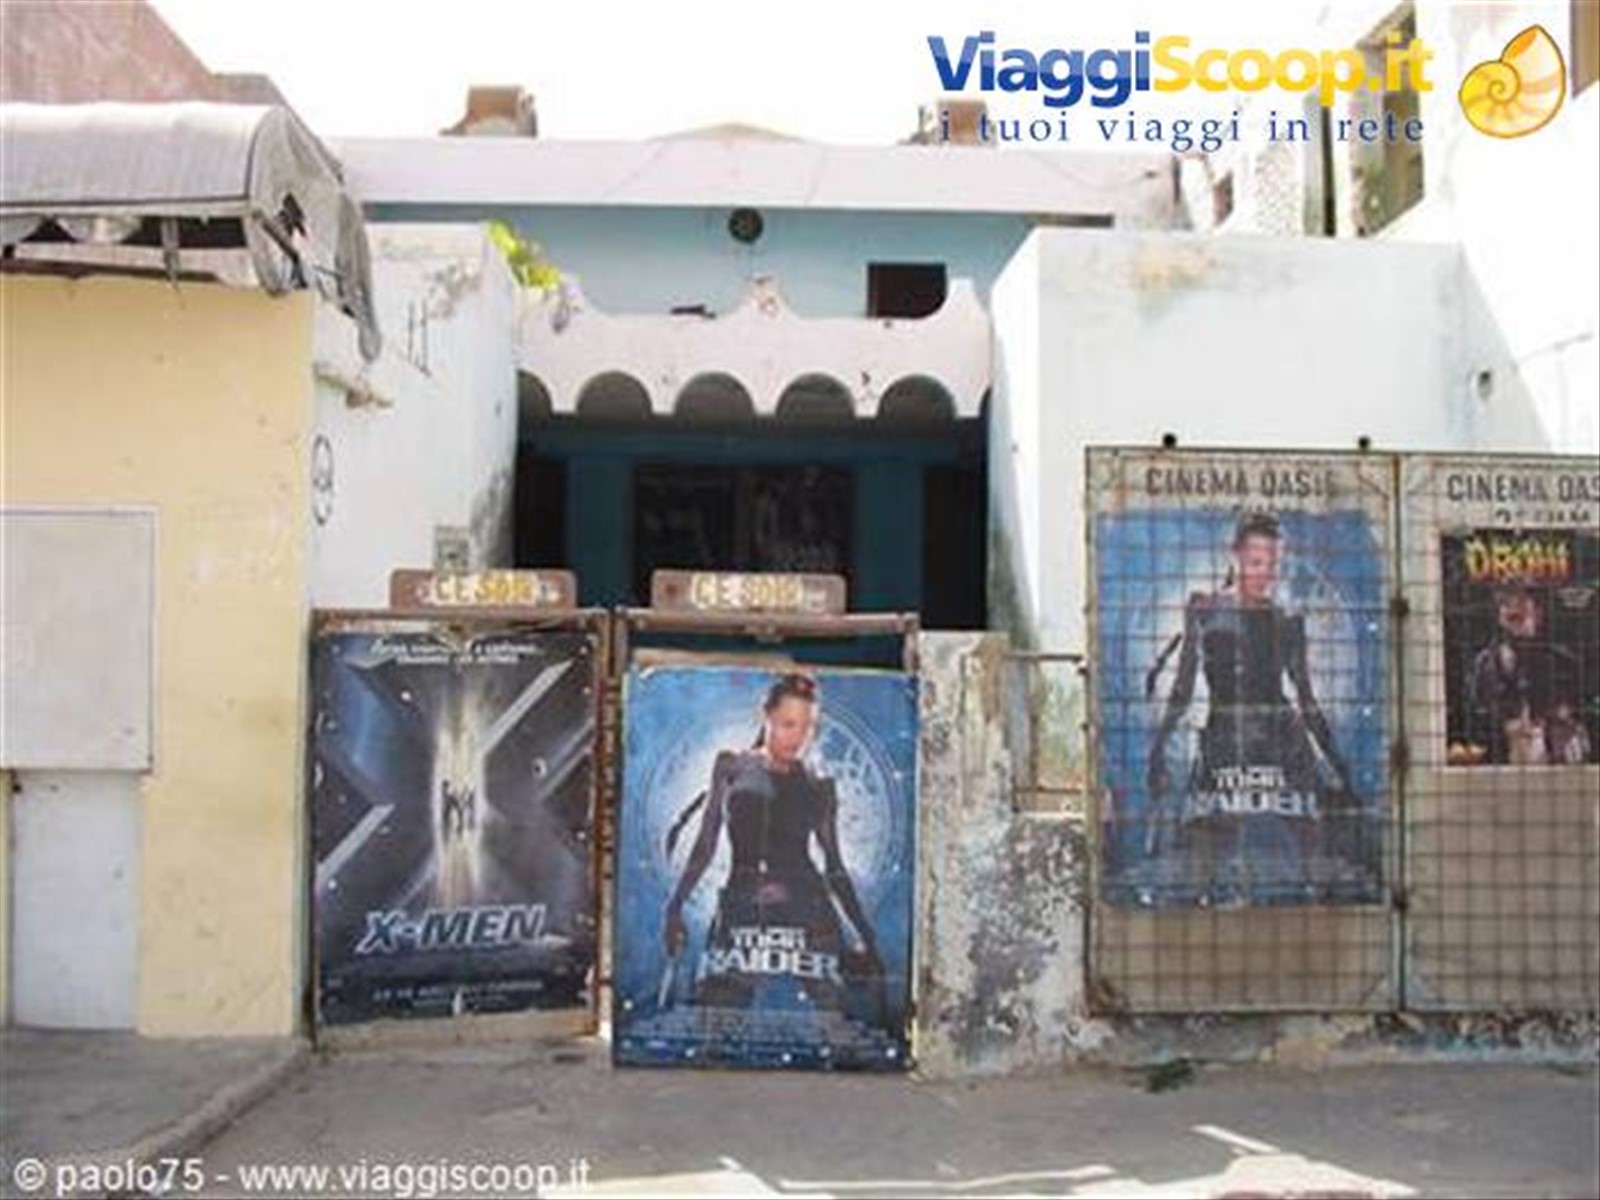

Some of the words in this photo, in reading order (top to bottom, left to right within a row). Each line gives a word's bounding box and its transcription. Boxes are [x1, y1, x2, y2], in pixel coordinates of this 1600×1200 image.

[1145, 467, 1249, 497] CINEMA
[1448, 474, 1548, 502] CINEMA
[355, 903, 547, 954] X-MEN
[695, 948, 843, 986] RAIDER
